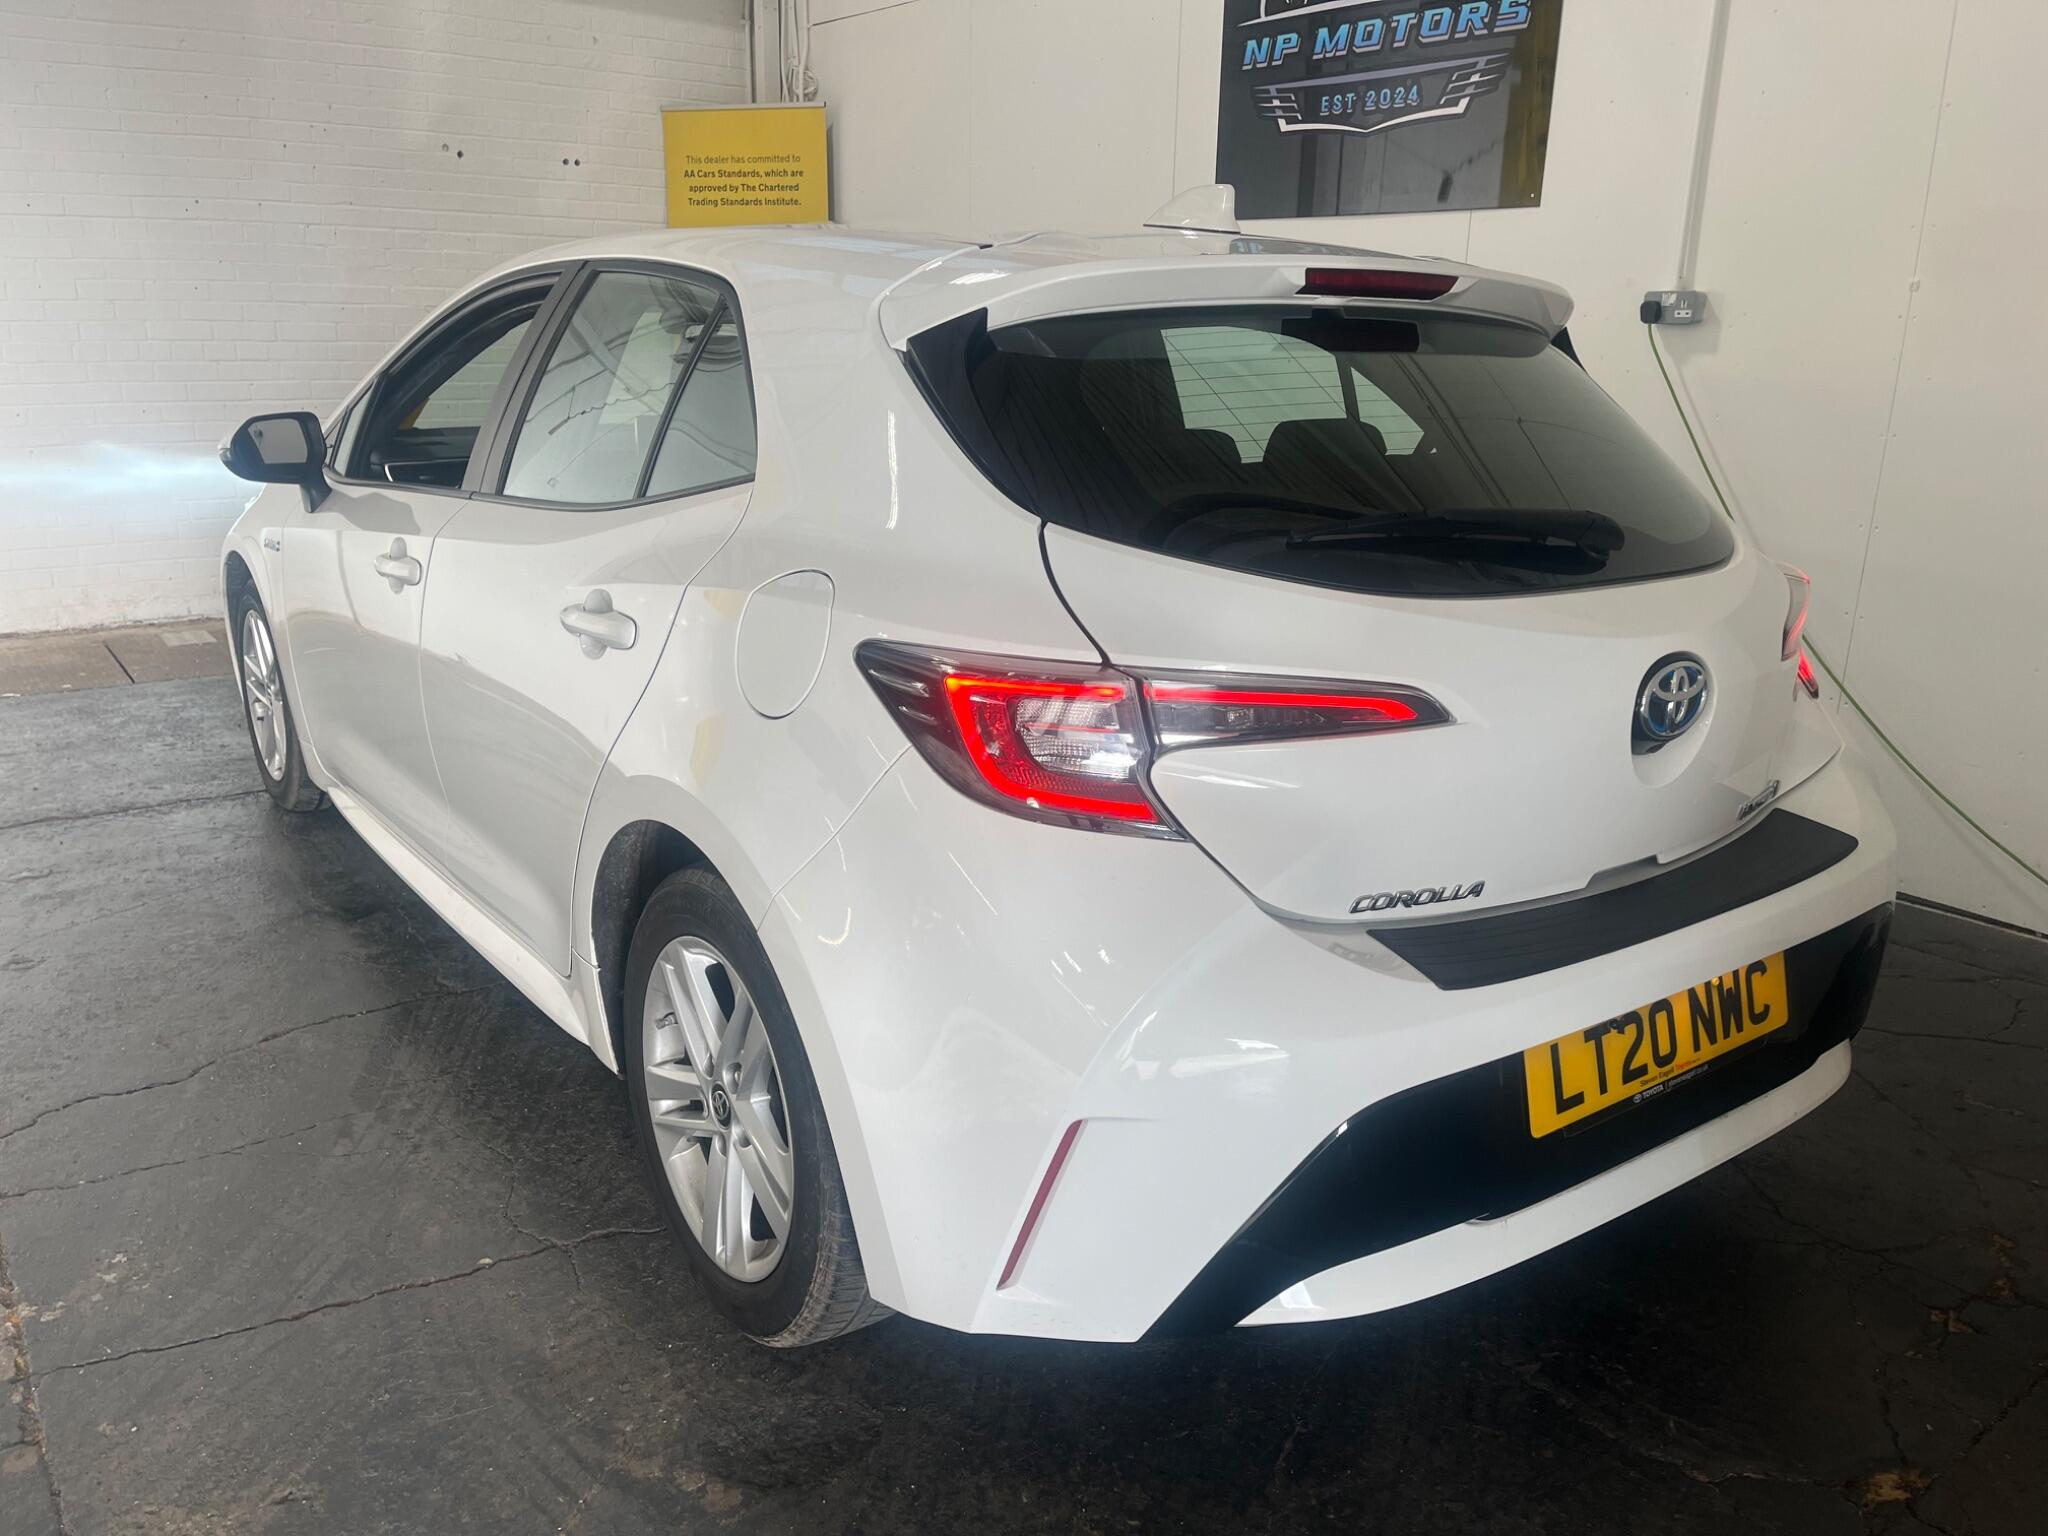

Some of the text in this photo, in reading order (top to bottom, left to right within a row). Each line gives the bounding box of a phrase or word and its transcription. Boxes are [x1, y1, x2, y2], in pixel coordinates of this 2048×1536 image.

[1241, 0, 1532, 70] NP MOTORS
[1320, 84, 1420, 116] EST 2024
[686, 154, 801, 164] This dealer has committed to
[684, 169, 695, 178] AA
[697, 169, 716, 178] Cars
[717, 169, 763, 179] Standards,
[764, 168, 788, 177] which
[689, 183, 800, 193] approved by The Chartered
[688, 197, 802, 208] Trading Standards Institute.
[1348, 879, 1486, 914] COROLLA
[1550, 960, 1771, 1115] LT20 NWC
